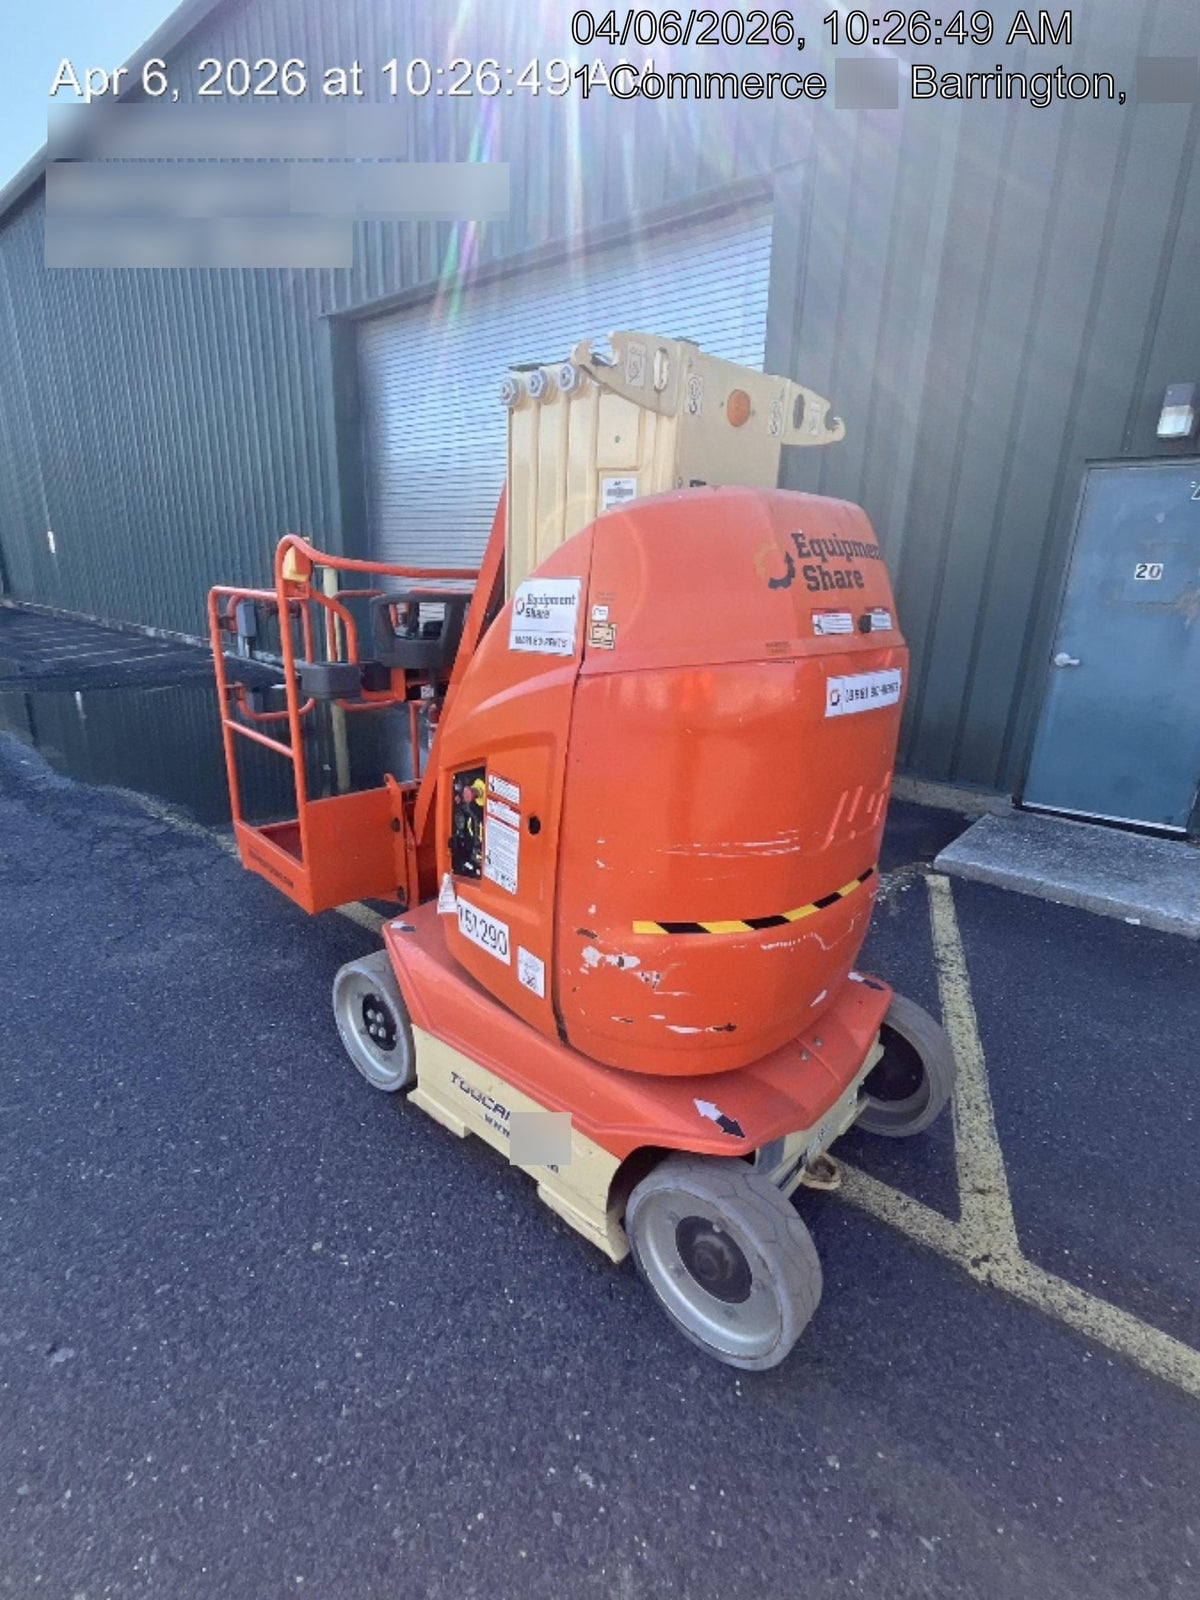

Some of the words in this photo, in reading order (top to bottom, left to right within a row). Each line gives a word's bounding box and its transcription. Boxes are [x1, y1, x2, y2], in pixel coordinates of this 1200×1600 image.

[791, 532, 884, 563] Equipmen
[803, 564, 865, 592] Share
[1135, 564, 1162, 579] 20
[525, 607, 551, 620] Share
